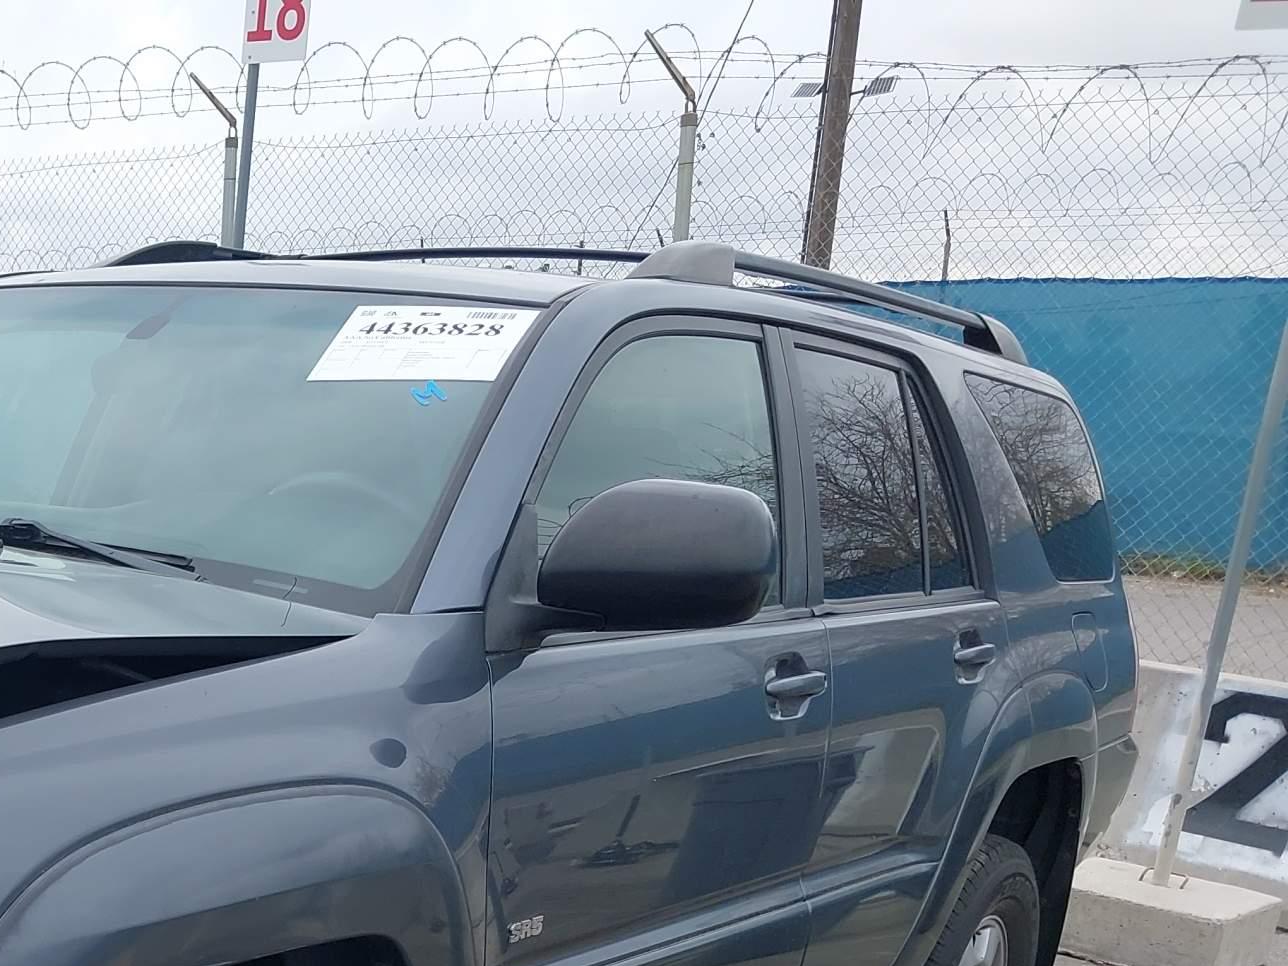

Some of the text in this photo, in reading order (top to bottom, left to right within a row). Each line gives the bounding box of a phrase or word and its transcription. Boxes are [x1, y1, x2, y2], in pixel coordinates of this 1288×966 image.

[246, 0, 306, 42] 18
[359, 322, 505, 337] 44363828
[509, 914, 545, 944] SR5
